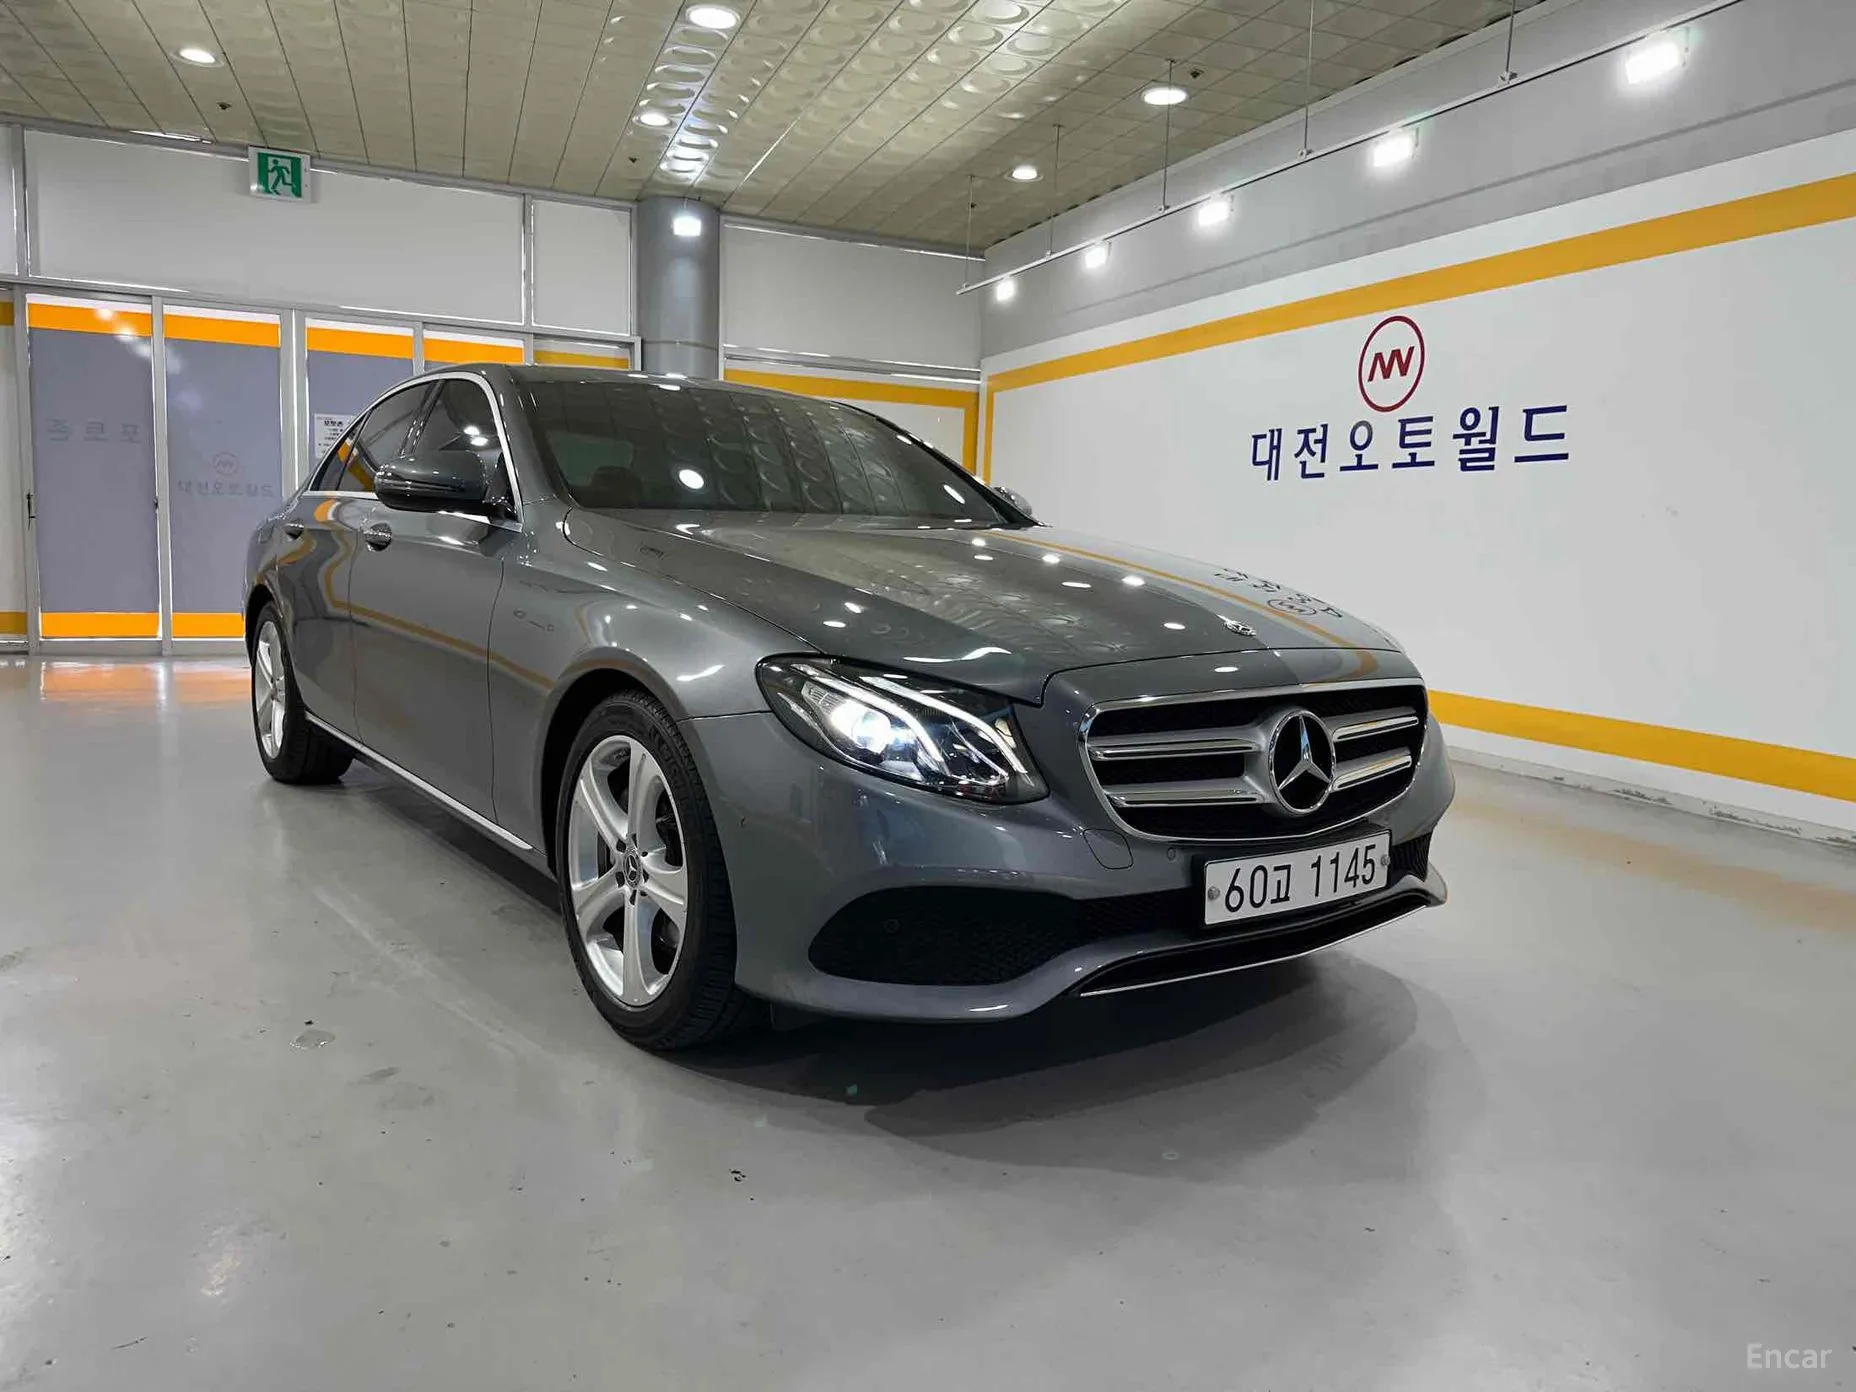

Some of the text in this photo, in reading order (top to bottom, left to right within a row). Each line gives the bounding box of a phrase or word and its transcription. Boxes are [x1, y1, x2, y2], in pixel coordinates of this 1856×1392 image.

[1251, 405, 1569, 481] 대전오토월드
[1225, 844, 1376, 913] 60고 1145
